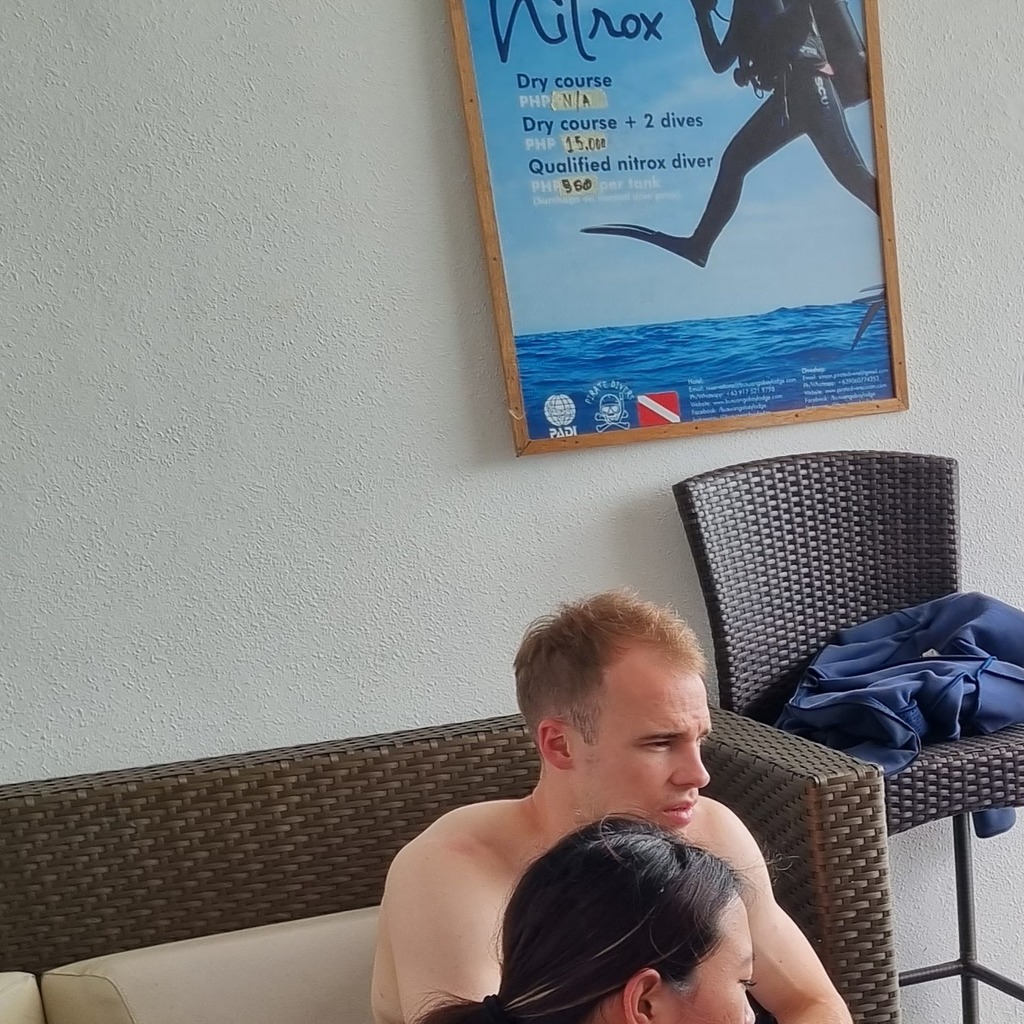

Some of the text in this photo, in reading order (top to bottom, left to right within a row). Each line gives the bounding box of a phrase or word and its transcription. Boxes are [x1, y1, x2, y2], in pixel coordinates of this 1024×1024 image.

[490, 0, 663, 63] Nitrox
[517, 73, 613, 92] Dry course
[519, 95, 550, 108] PHP
[562, 90, 591, 112] N/A
[523, 112, 703, 135] Dry course + 2 dives
[525, 138, 556, 151] PHP
[529, 153, 713, 175] Qualified nitrox diver
[584, 380, 636, 405] PIRATE DIVERS
[549, 426, 578, 439] PADI
